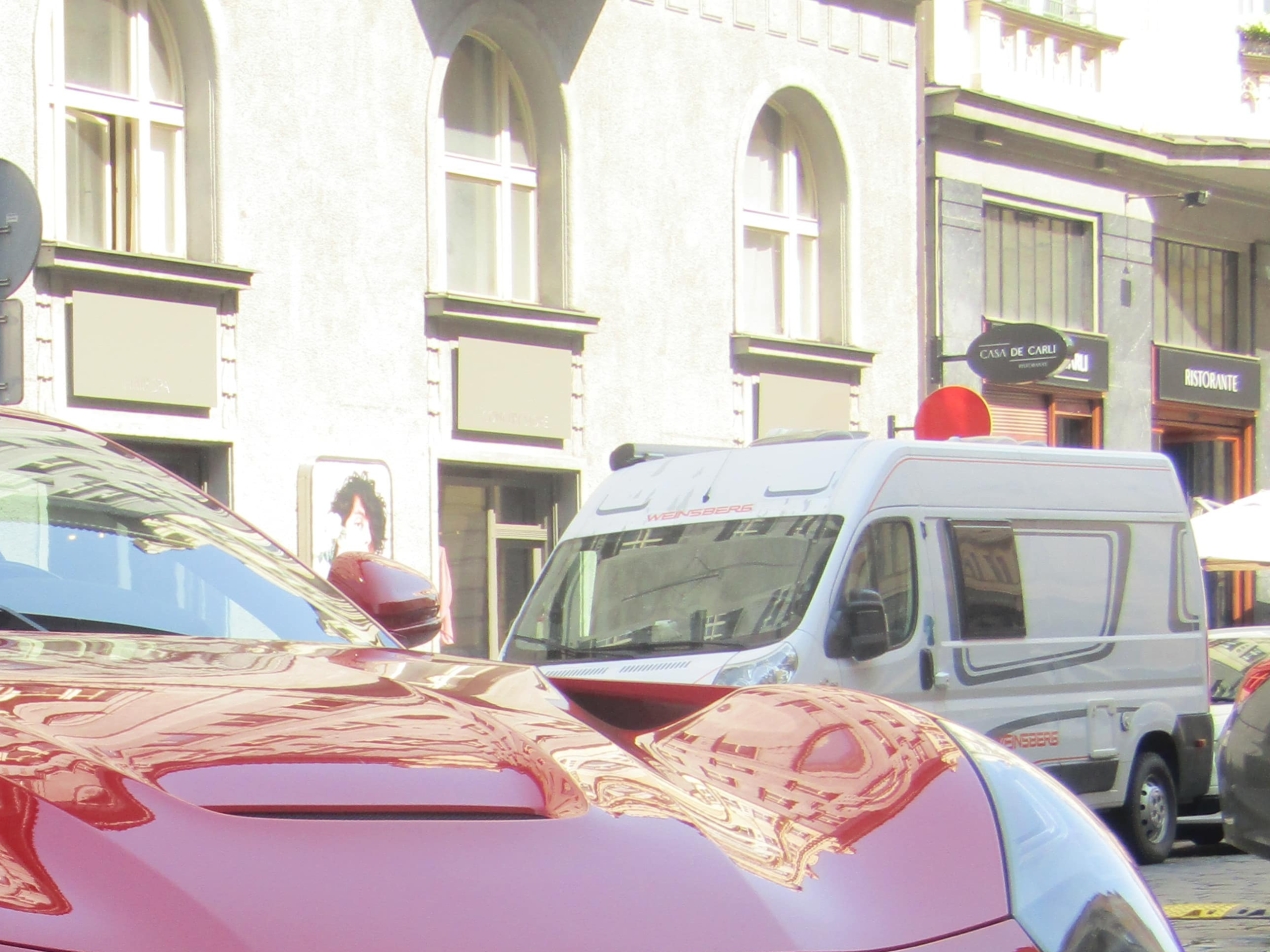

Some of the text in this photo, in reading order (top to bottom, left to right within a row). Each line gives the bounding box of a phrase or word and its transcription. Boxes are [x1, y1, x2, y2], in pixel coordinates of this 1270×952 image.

[980, 344, 1056, 360] CASA DE CARLI
[1184, 368, 1238, 392] RISTORANTE
[647, 504, 754, 522] WEINSBERG
